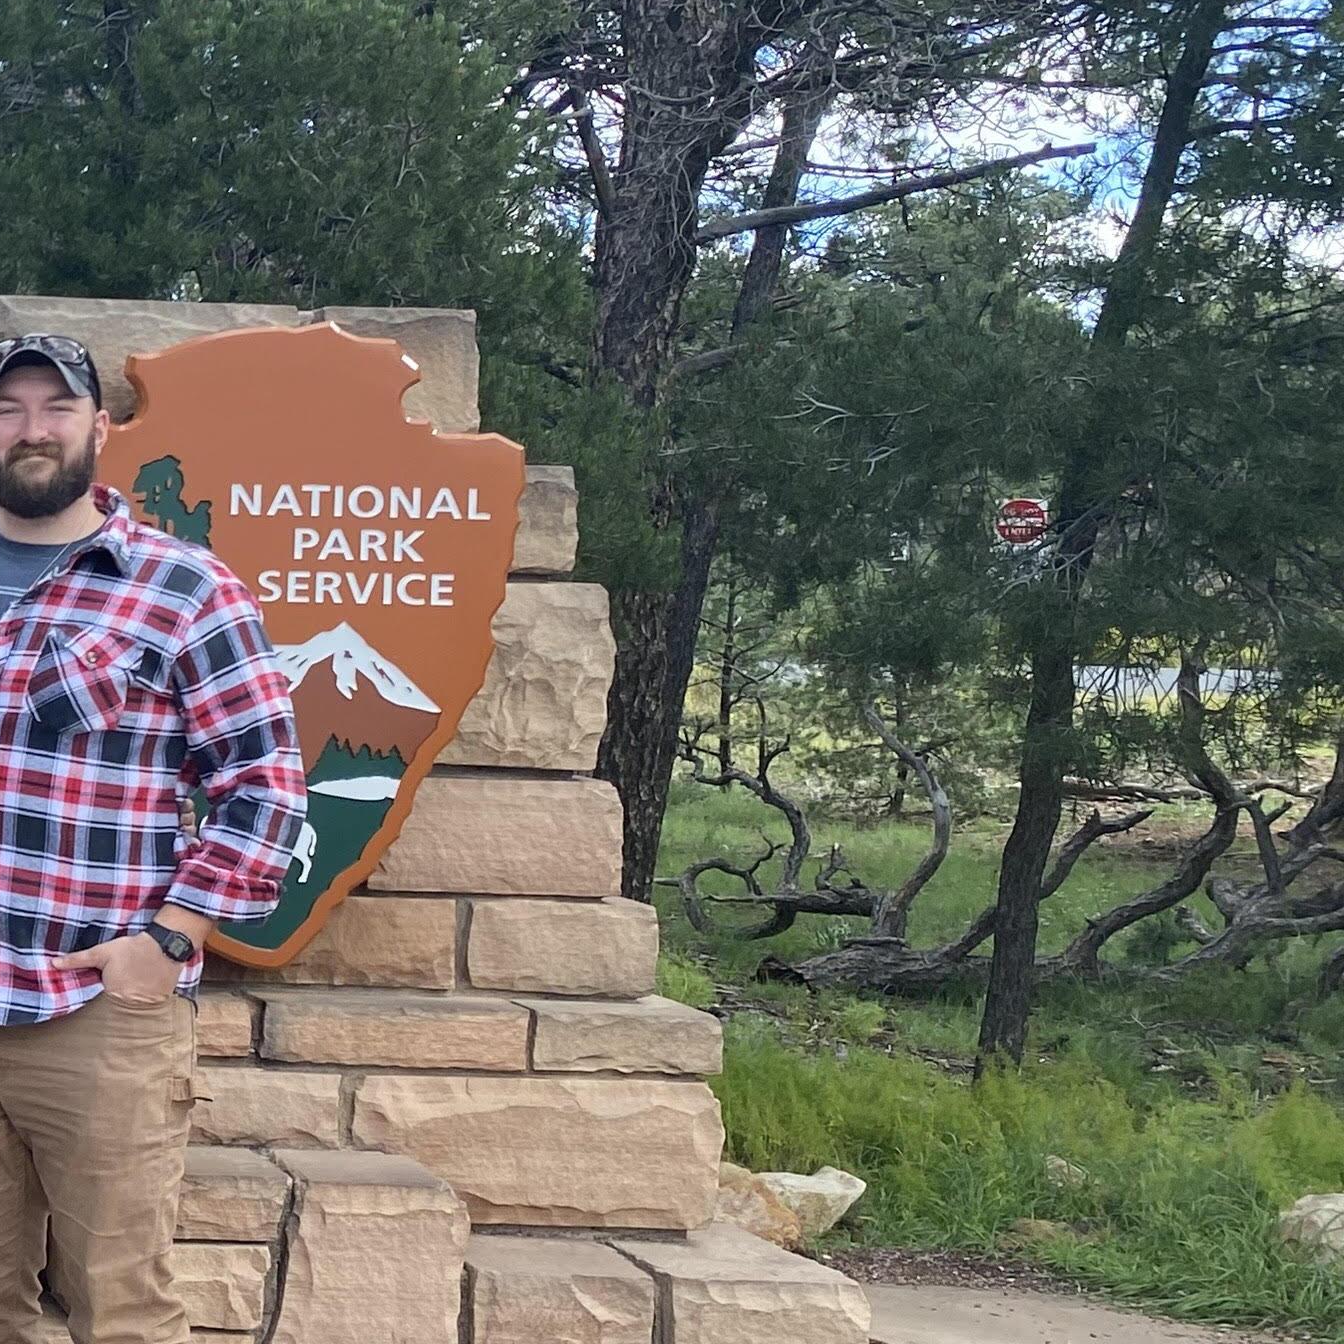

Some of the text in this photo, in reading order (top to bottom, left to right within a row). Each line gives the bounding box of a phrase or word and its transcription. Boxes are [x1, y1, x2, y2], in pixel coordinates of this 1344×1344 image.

[229, 483, 491, 520] NATIONAL
[293, 527, 425, 562] PARK
[257, 570, 455, 606] SERVICE
